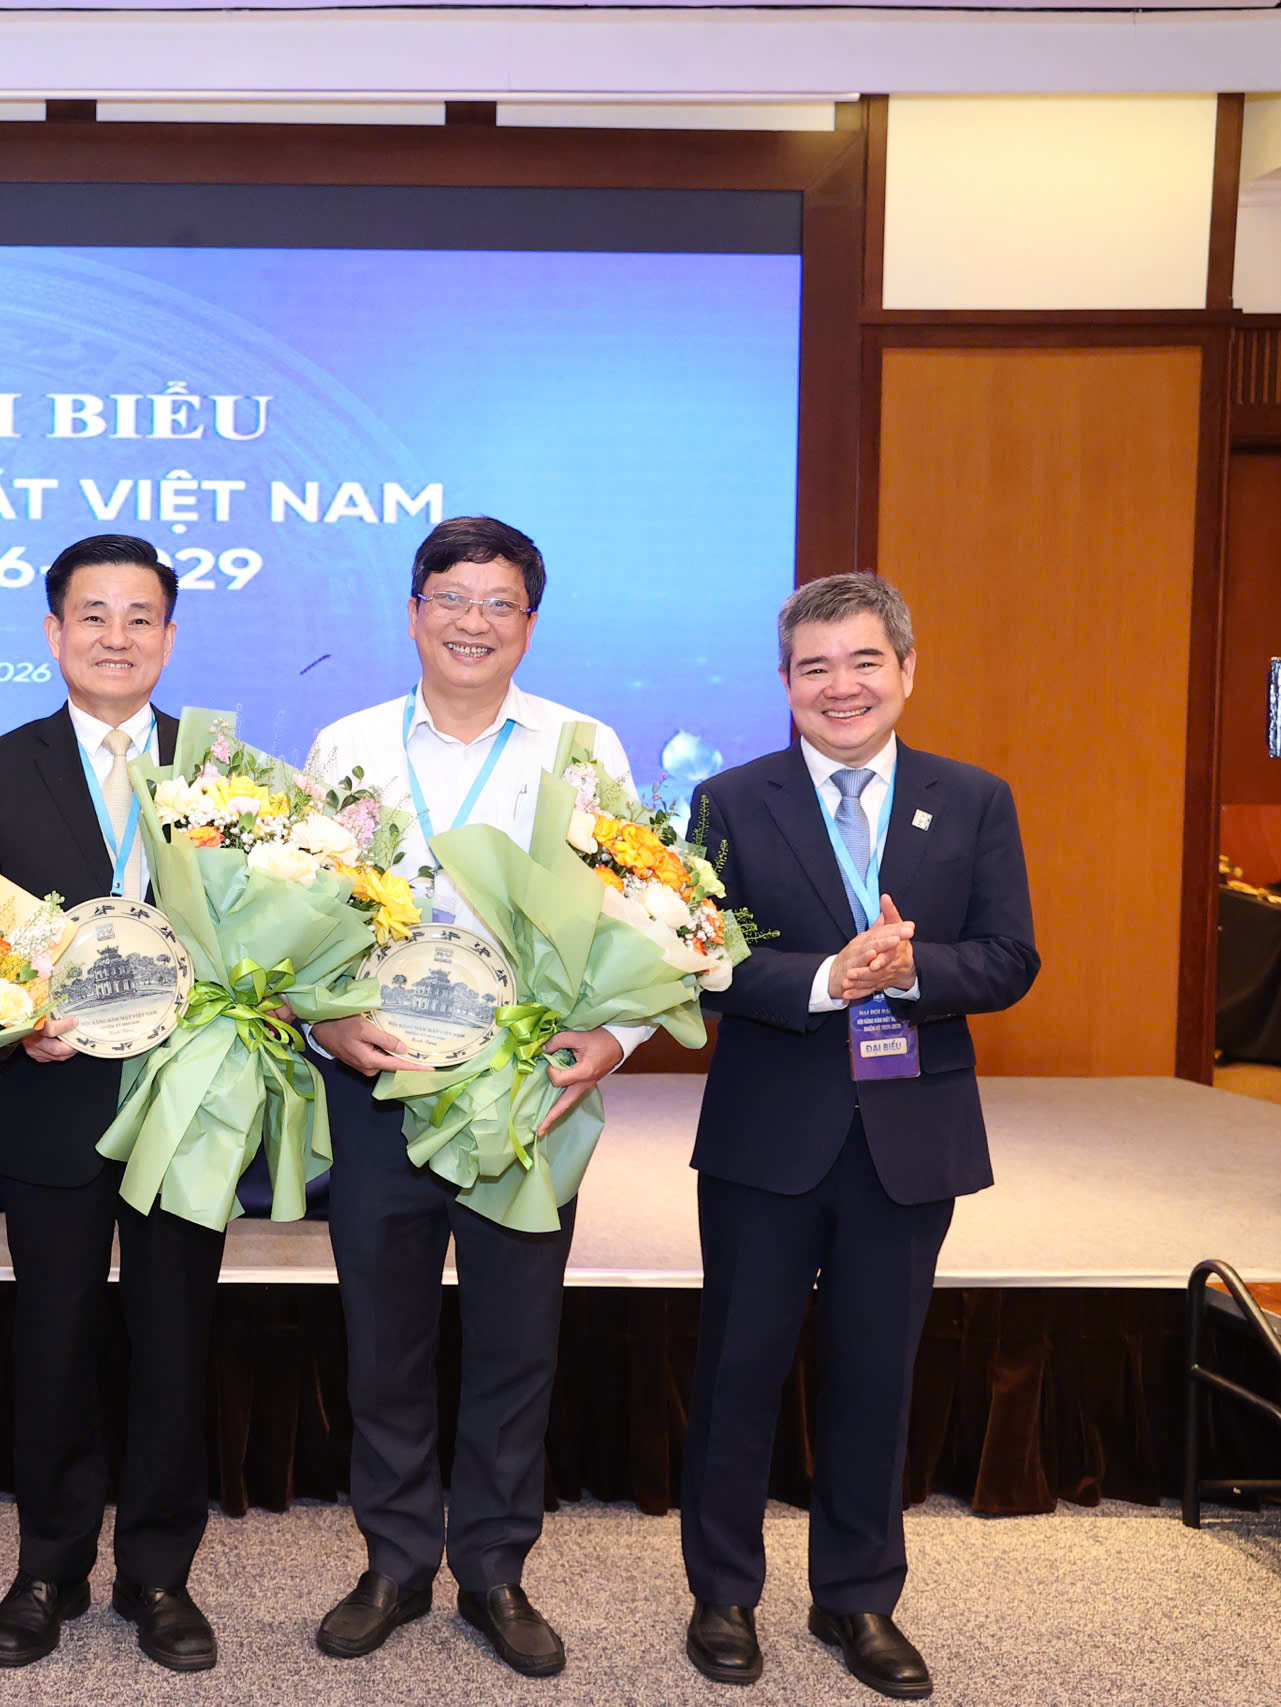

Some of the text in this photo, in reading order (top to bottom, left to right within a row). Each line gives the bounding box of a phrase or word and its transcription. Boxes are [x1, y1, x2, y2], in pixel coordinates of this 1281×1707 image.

[46, 381, 272, 441] BIỂU
[81, 470, 246, 534] VIỆT
[270, 482, 443, 524] NAM
